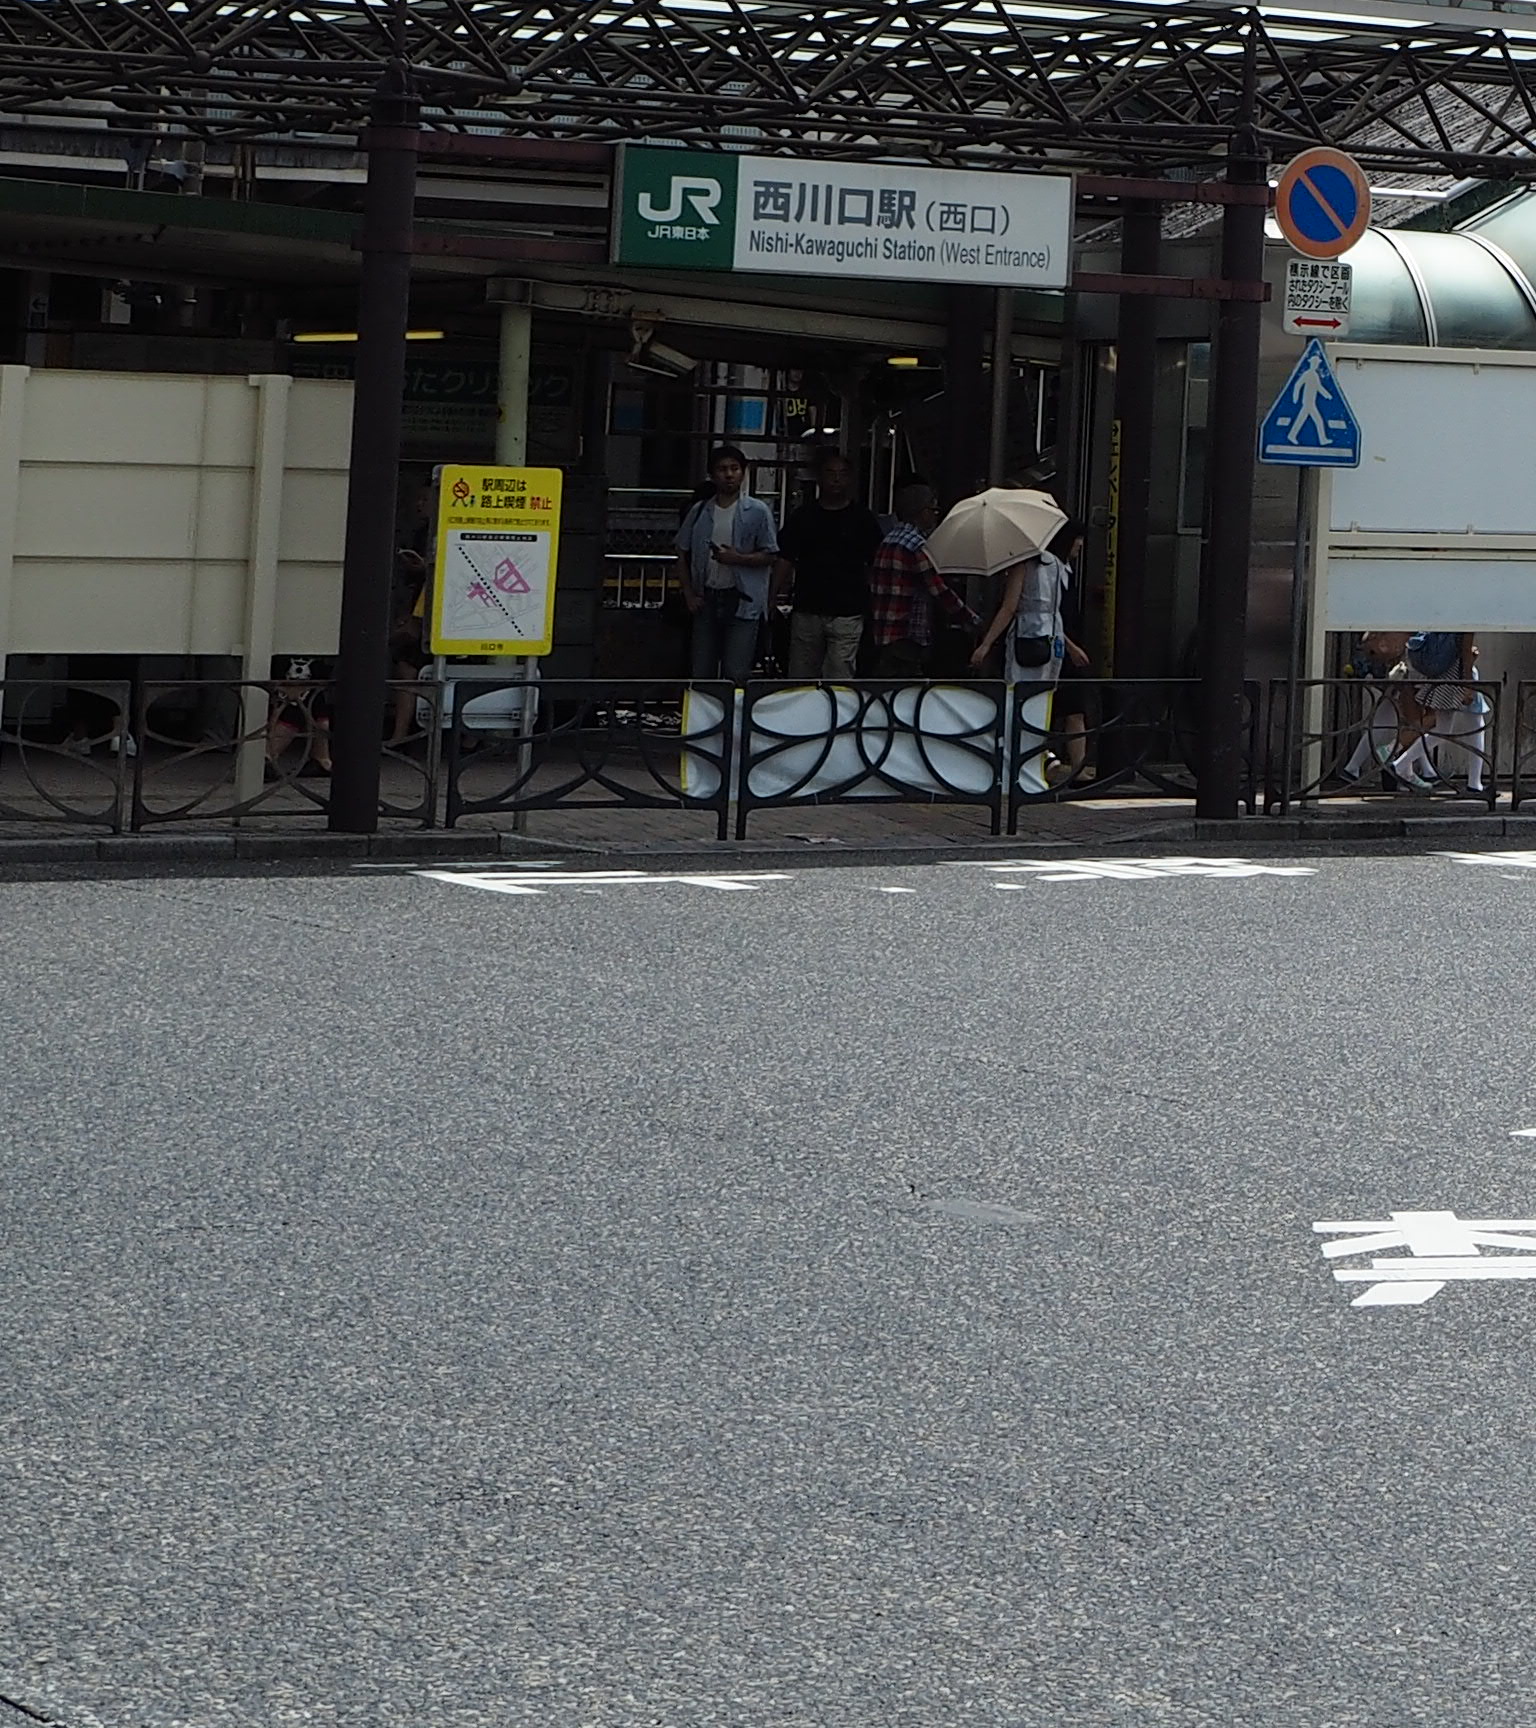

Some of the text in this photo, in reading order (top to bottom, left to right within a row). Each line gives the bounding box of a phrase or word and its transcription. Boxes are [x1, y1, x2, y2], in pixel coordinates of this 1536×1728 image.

[638, 175, 722, 225] JR
[647, 224, 711, 241] JR東日本
[749, 230, 1052, 271] Nishi-Kawaguchi Station (West Entrance)
[481, 478, 527, 492] 駅周辺は
